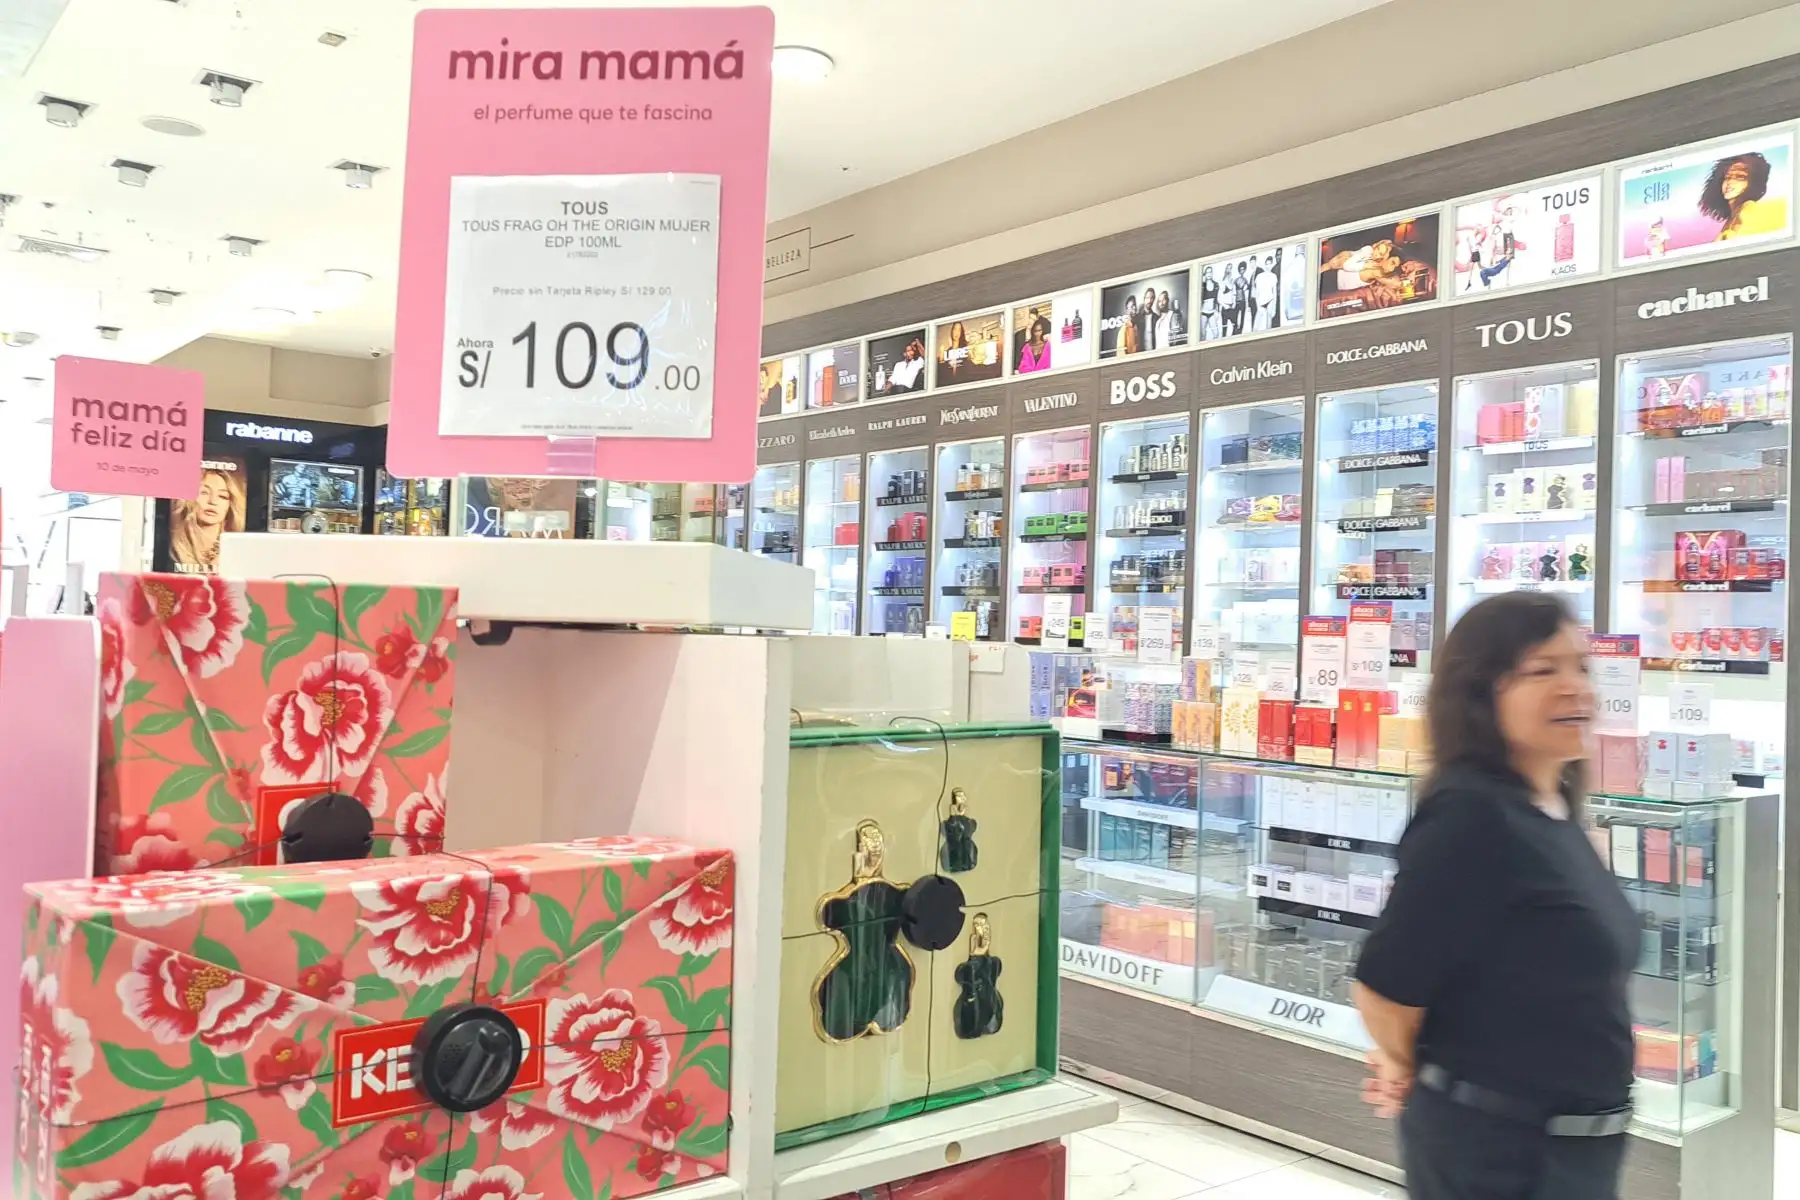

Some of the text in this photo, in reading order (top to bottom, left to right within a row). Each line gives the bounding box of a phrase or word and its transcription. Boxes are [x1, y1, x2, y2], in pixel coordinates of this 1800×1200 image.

[448, 37, 745, 81] mira mamá
[473, 104, 713, 124] el perfume que te fascina
[560, 201, 609, 216] TOUS
[1542, 187, 1590, 212] TOUS
[462, 218, 710, 233] TOUS FRAG OH THE ORIGIN MUJER
[544, 236, 622, 249] EDP 100ML
[766, 248, 802, 268] BELLEZA
[1637, 276, 1770, 320] cacharel
[1475, 311, 1574, 348] TOUS
[456, 338, 494, 349] Ahora
[1326, 338, 1428, 365] DOLCE&GABBANA
[458, 350, 491, 388] S/
[1210, 360, 1293, 386] Calvin Klein
[1110, 371, 1176, 405] BOSS
[71, 396, 188, 427] mamá
[1024, 392, 1079, 414] VALENTINO
[225, 421, 314, 445] rabanne
[868, 415, 927, 431] RALPH LAUREN
[71, 422, 187, 453] feliz día
[97, 461, 110, 471] 10
[131, 464, 160, 476] mayo
[1317, 669, 1338, 686] 89
[1362, 660, 1383, 672] 109
[1606, 699, 1632, 713] 109
[1062, 943, 1164, 986] DAVIDOFF
[1269, 996, 1327, 1027] DIOR
